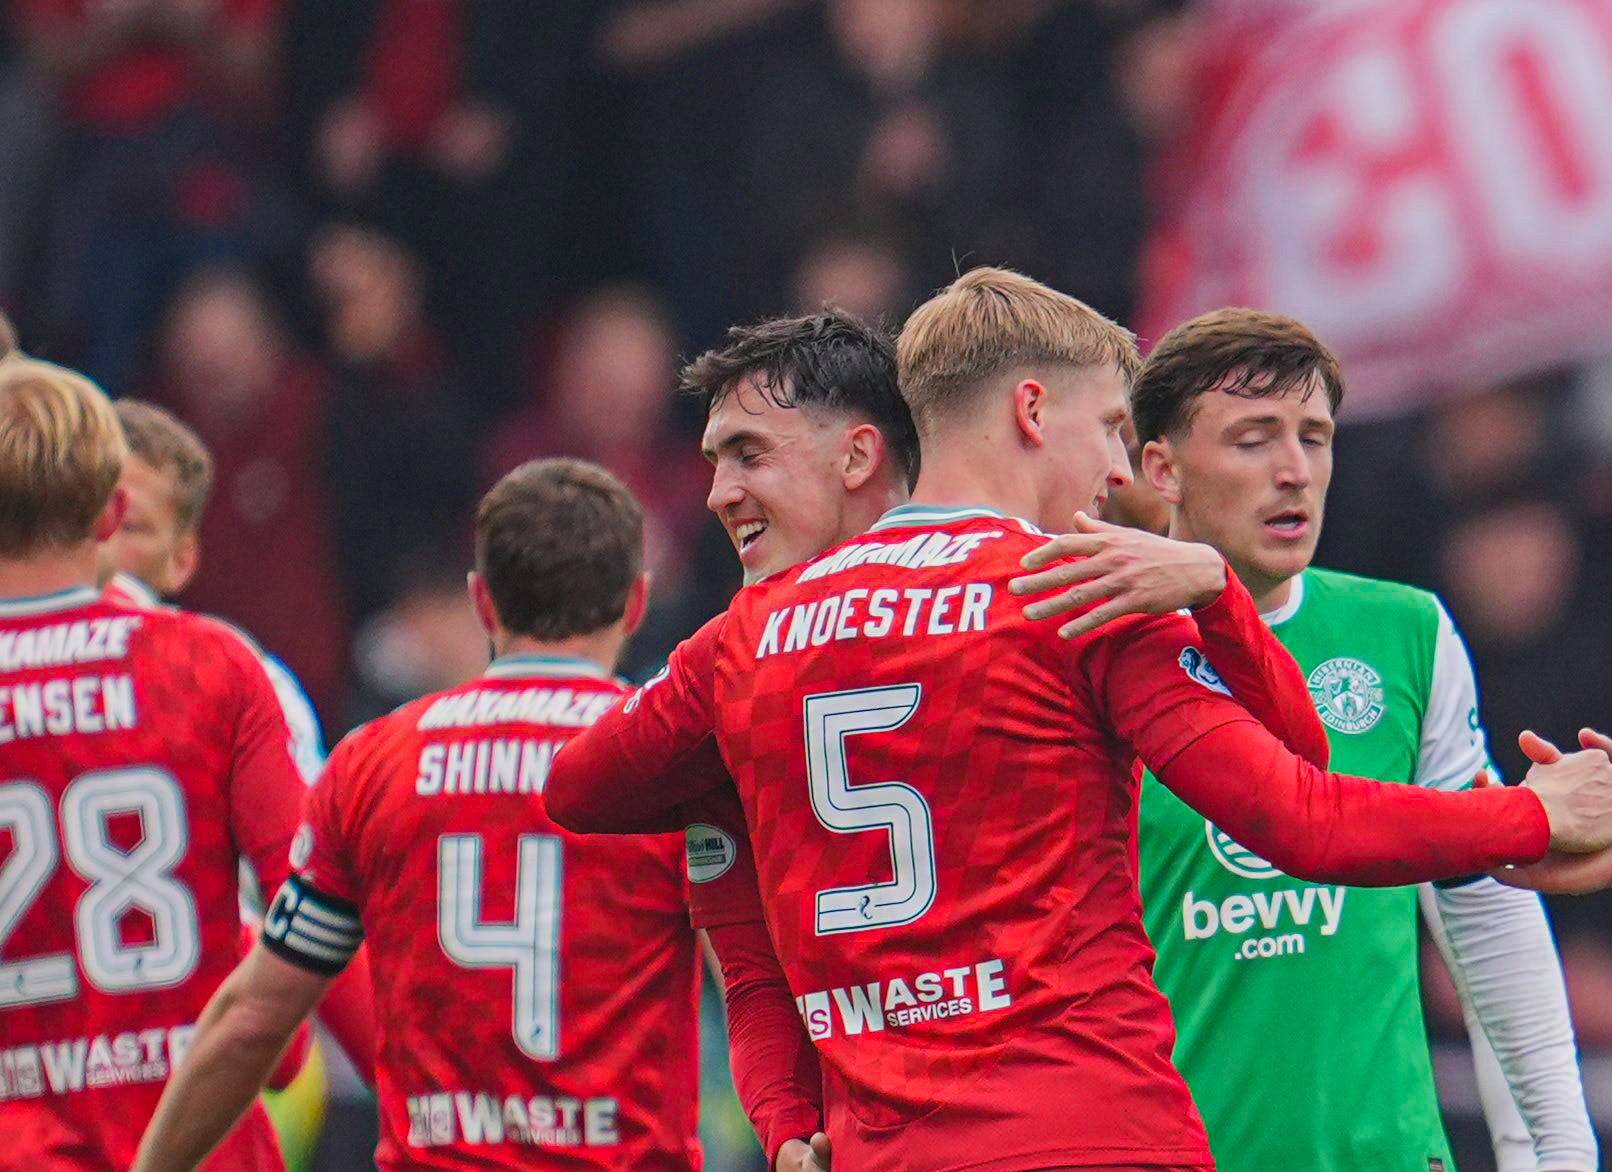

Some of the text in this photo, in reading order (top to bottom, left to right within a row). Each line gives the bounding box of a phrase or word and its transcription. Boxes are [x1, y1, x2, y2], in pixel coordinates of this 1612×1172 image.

[755, 582, 993, 659] KNOESTER
[415, 738, 567, 796] SHINN
[803, 682, 937, 937] 5
[0, 768, 203, 1012] 28
[263, 878, 298, 941] C
[1183, 886, 1345, 941] bevvy
[438, 832, 564, 1062] 4
[1234, 933, 1305, 961] .com
[832, 960, 1011, 1036] WASTE
[886, 998, 973, 1028] SERVICES
[454, 1091, 619, 1146] WASTE
